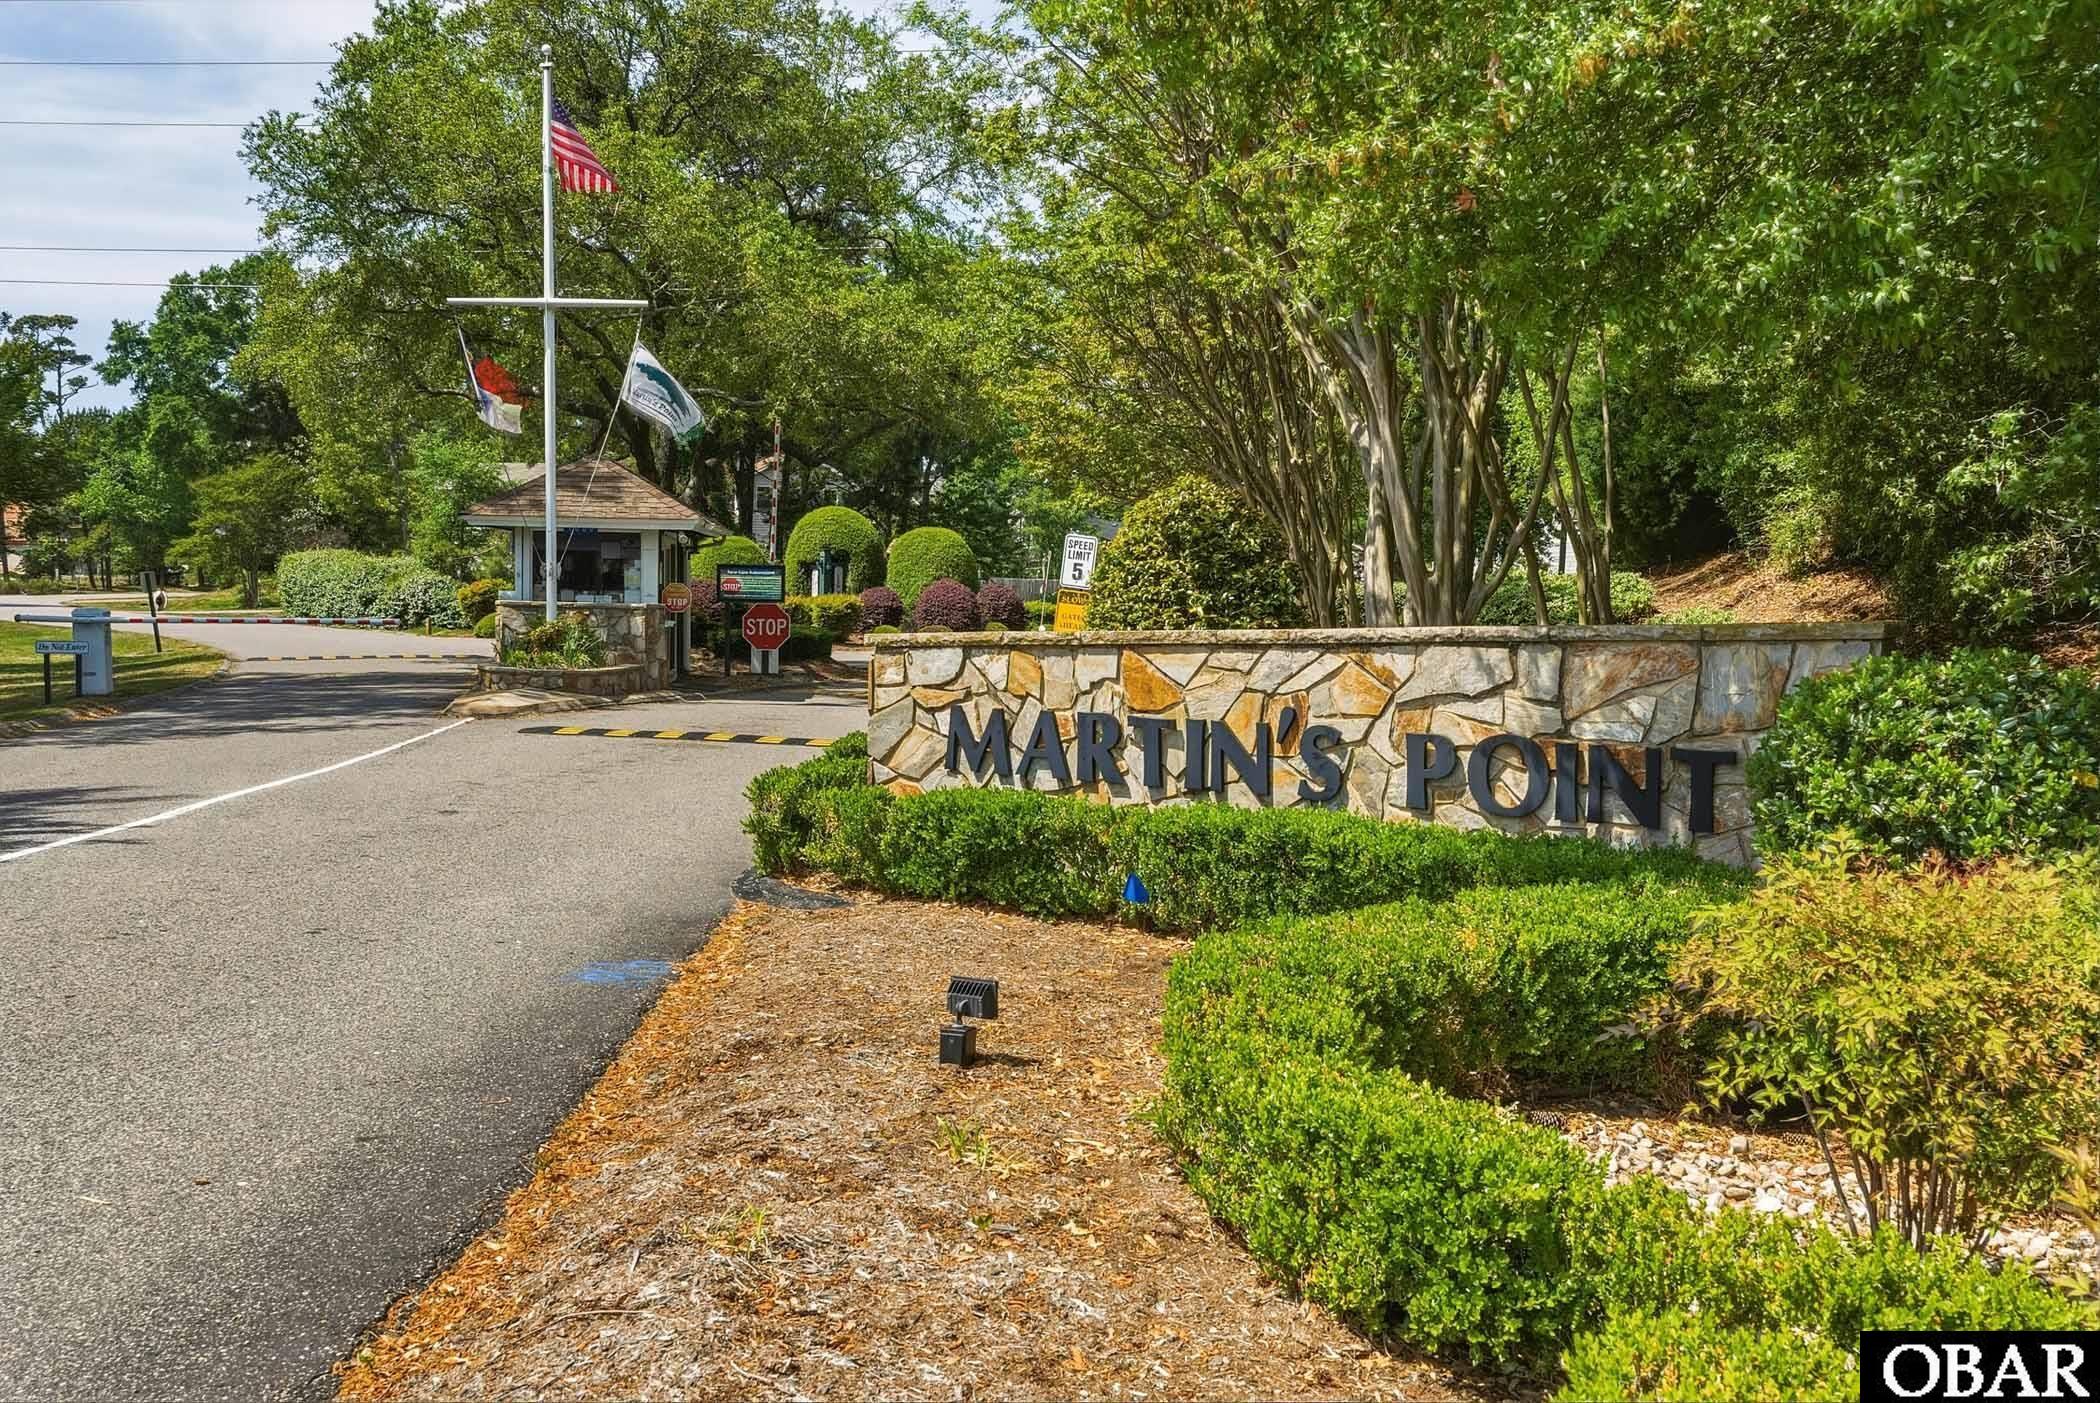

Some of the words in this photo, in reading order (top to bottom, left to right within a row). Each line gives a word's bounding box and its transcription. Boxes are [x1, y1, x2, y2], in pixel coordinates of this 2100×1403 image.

[1068, 539, 1094, 551] SPEED
[1068, 550, 1091, 561] LIMIT
[1072, 563, 1083, 580] 5
[667, 598, 688, 607] STOP
[746, 618, 787, 636] STOP
[944, 706, 1345, 801] MARTIN'S
[1404, 733, 1737, 833] POINT
